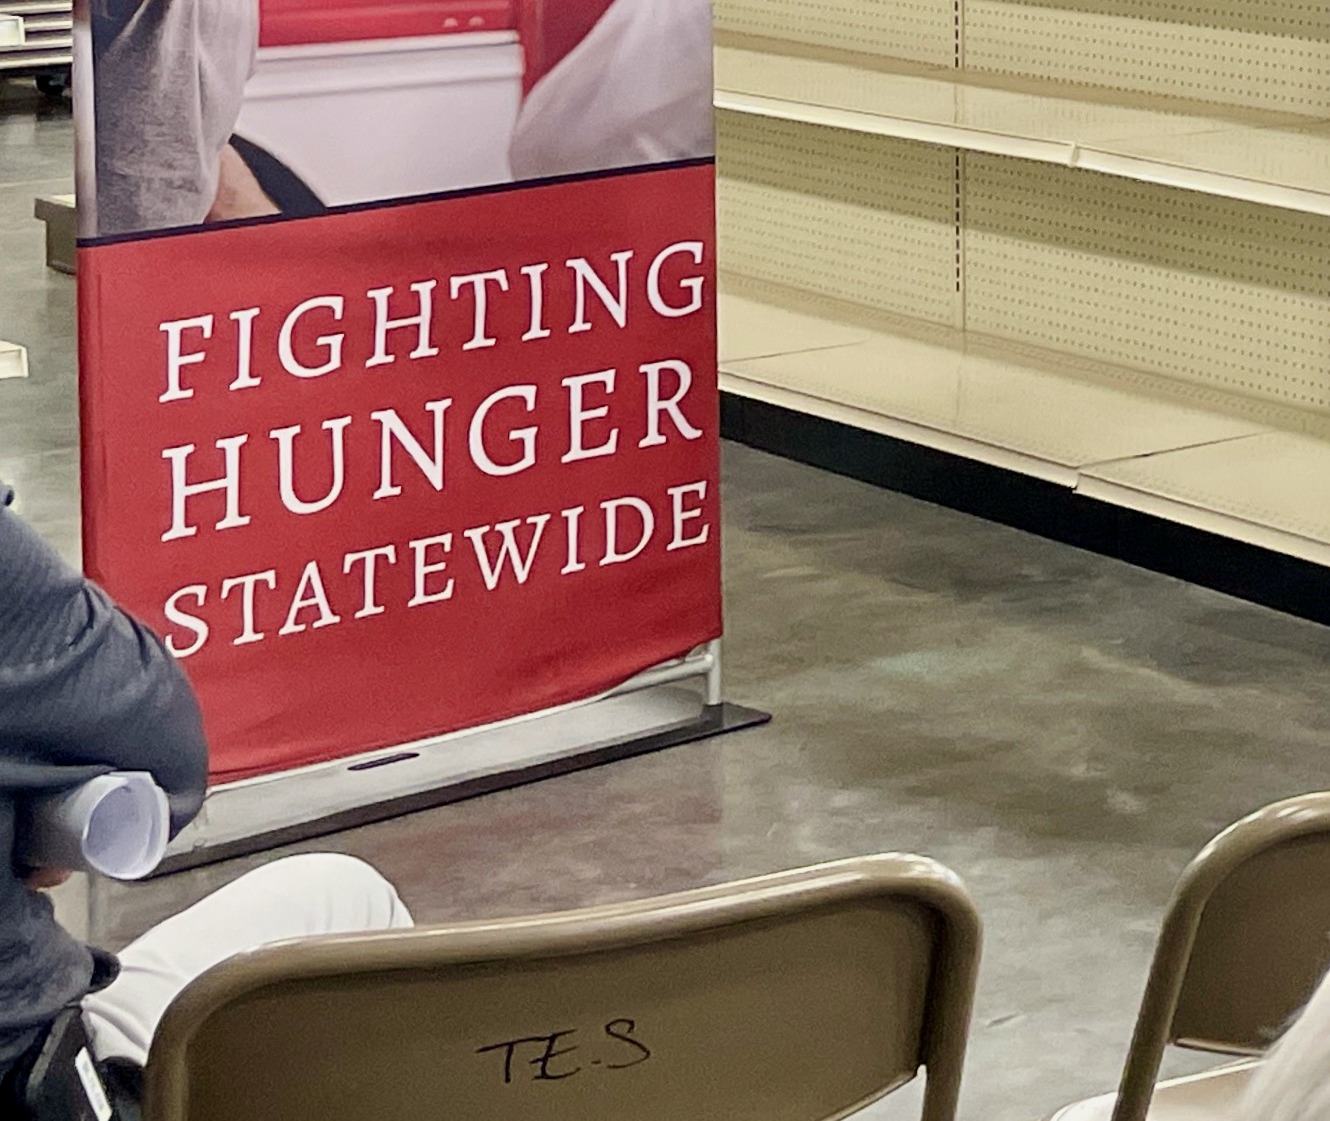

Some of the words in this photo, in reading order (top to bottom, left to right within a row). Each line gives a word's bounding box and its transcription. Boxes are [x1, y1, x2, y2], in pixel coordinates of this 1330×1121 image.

[157, 240, 706, 404] FIGHTING
[160, 358, 704, 543] HUNGER
[162, 479, 711, 660] STATEWIDE
